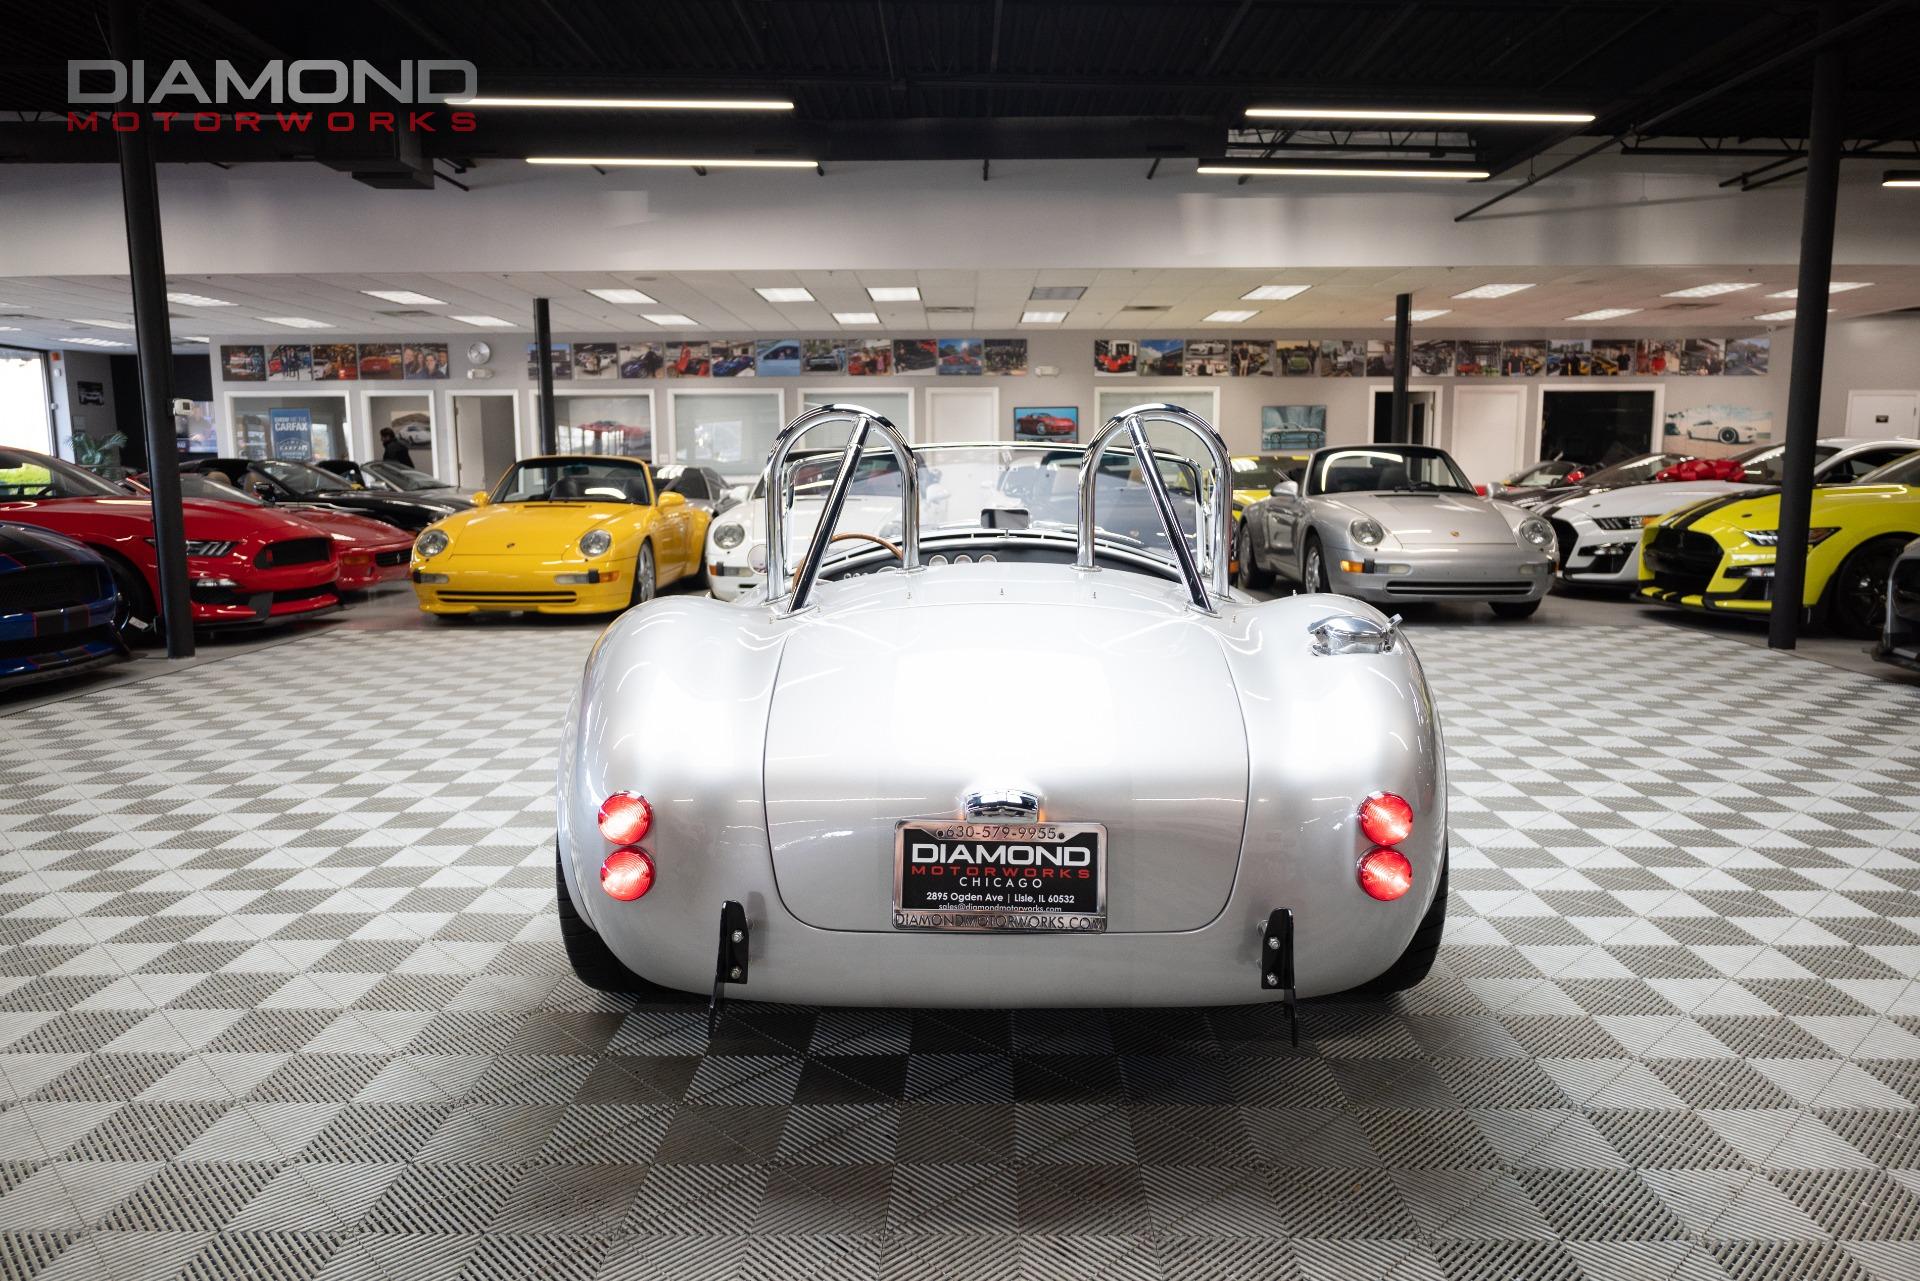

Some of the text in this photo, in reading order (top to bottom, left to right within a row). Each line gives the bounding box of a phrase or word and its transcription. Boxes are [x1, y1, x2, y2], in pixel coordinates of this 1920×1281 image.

[274, 422, 308, 431] CARFAX
[946, 825, 1057, 840] 630-579-9955
[912, 843, 1091, 867] DIAMOND
[911, 865, 1090, 879] MOTORWORKS
[959, 876, 1042, 889] CHICAGO
[926, 892, 948, 901] 2895
[950, 892, 983, 904] Ogden
[985, 893, 1004, 902] Ave
[1038, 894, 1046, 903] IL
[1047, 894, 1075, 904] 60532
[938, 903, 1062, 912] sales@diamondmotorworks.com
[896, 914, 1106, 929] DIAMONDMOTORWORKS.COM
